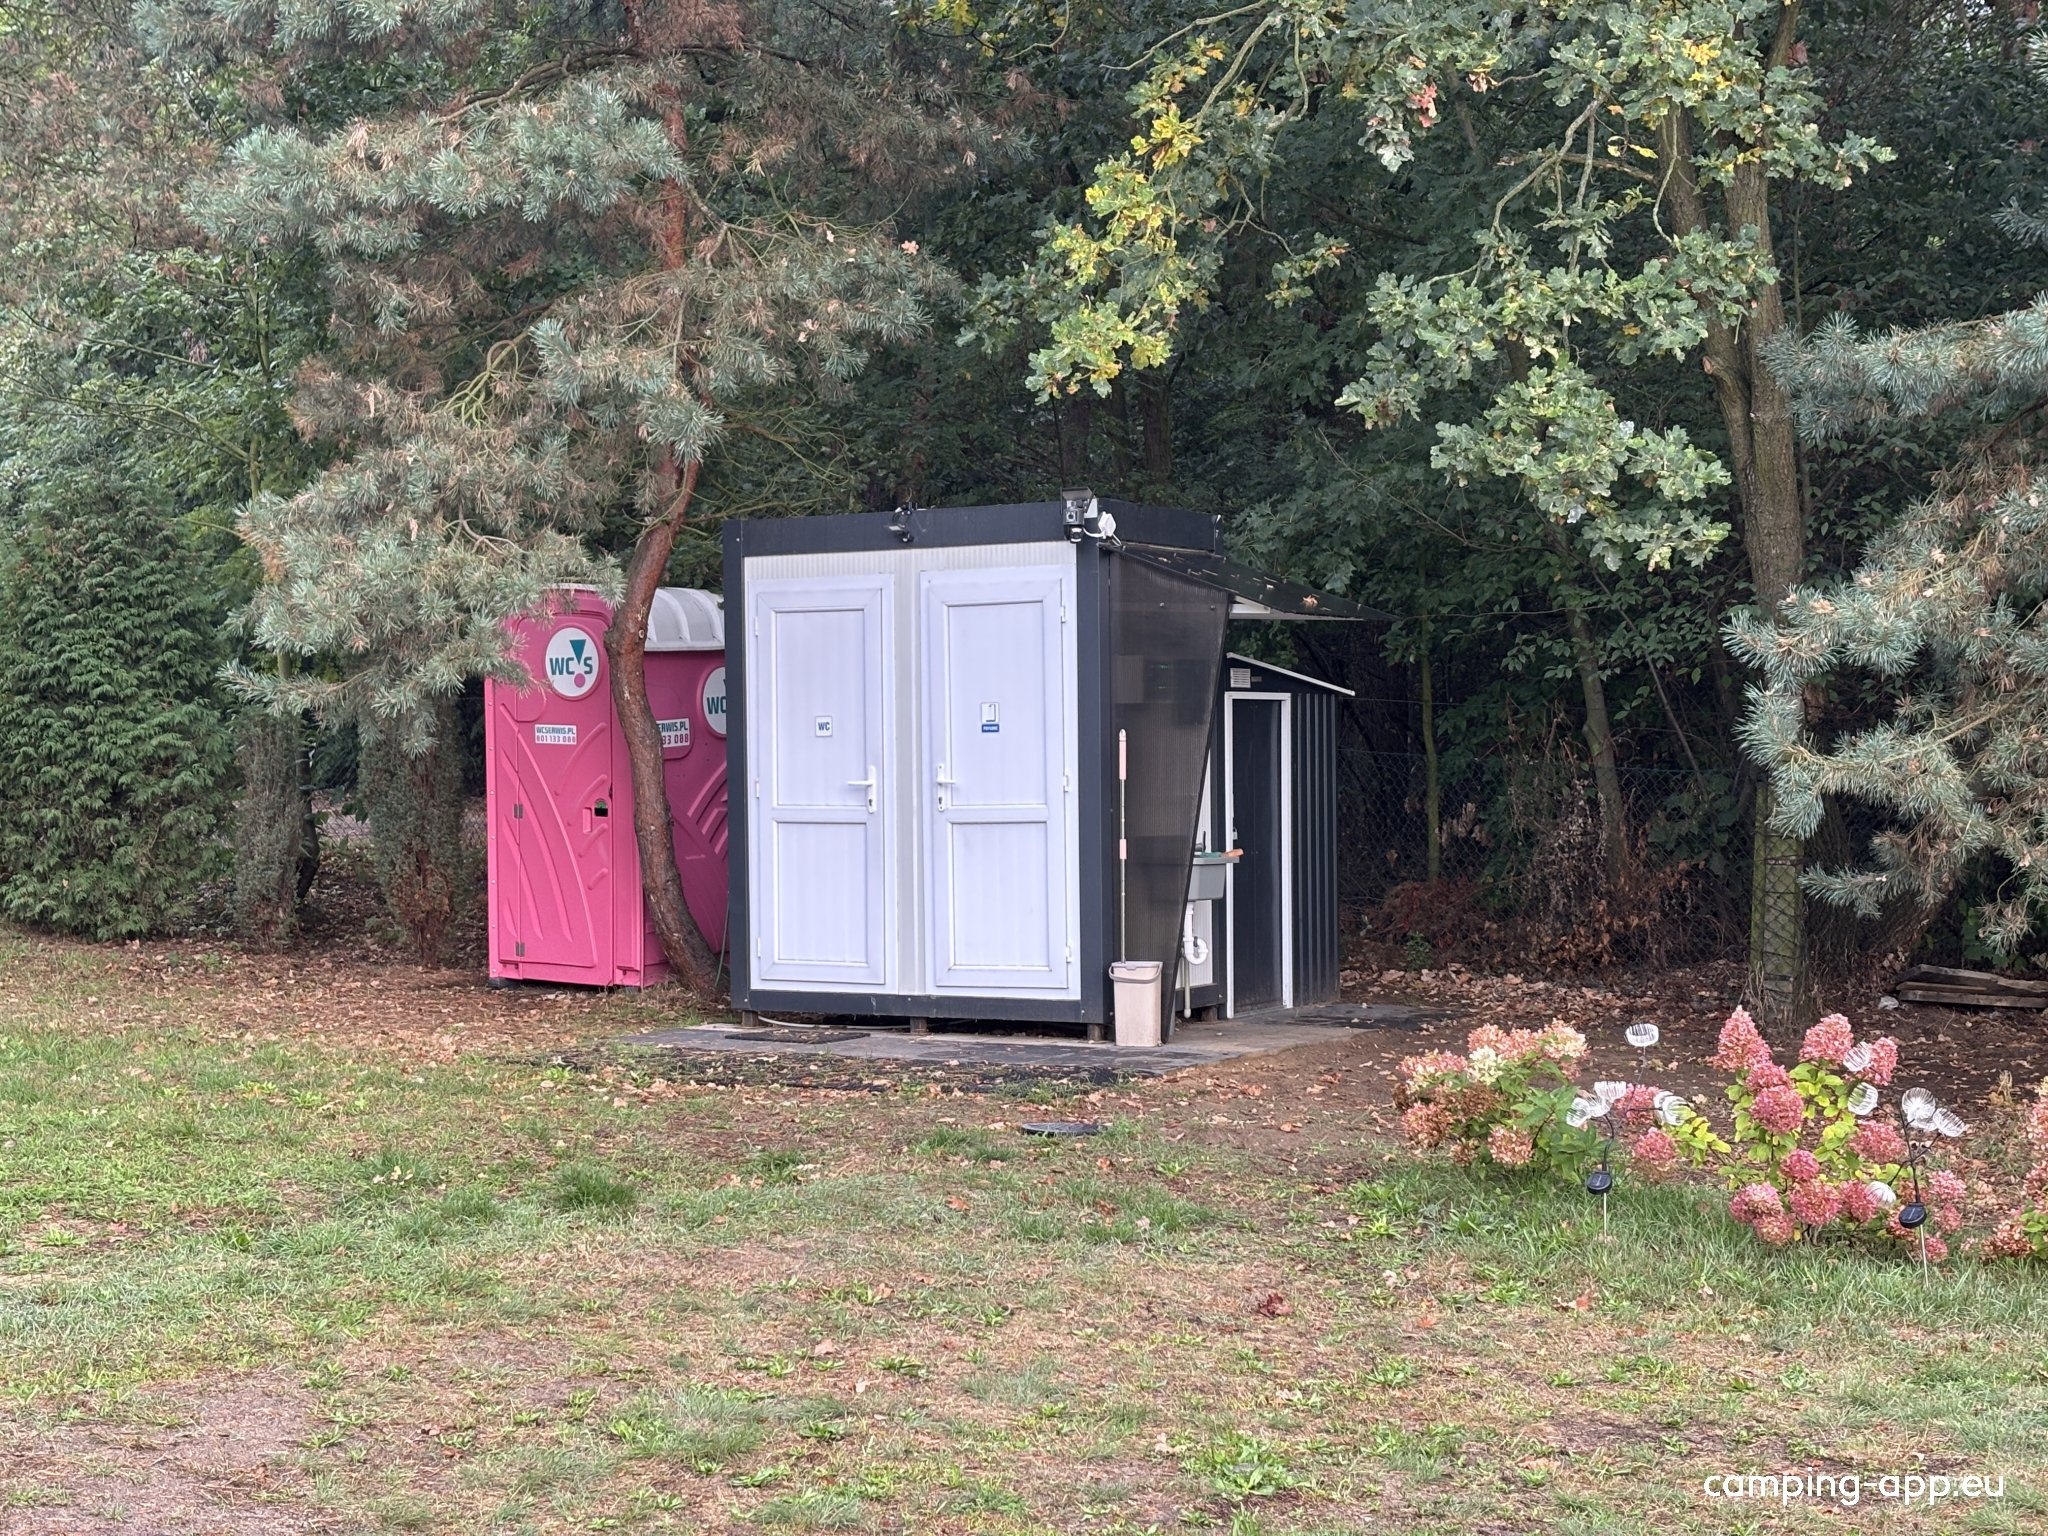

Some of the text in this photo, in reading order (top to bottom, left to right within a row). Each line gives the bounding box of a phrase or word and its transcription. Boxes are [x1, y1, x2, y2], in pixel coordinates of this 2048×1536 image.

[817, 721, 831, 731] WC
[549, 735, 561, 743] 133
[674, 733, 689, 744] 088
